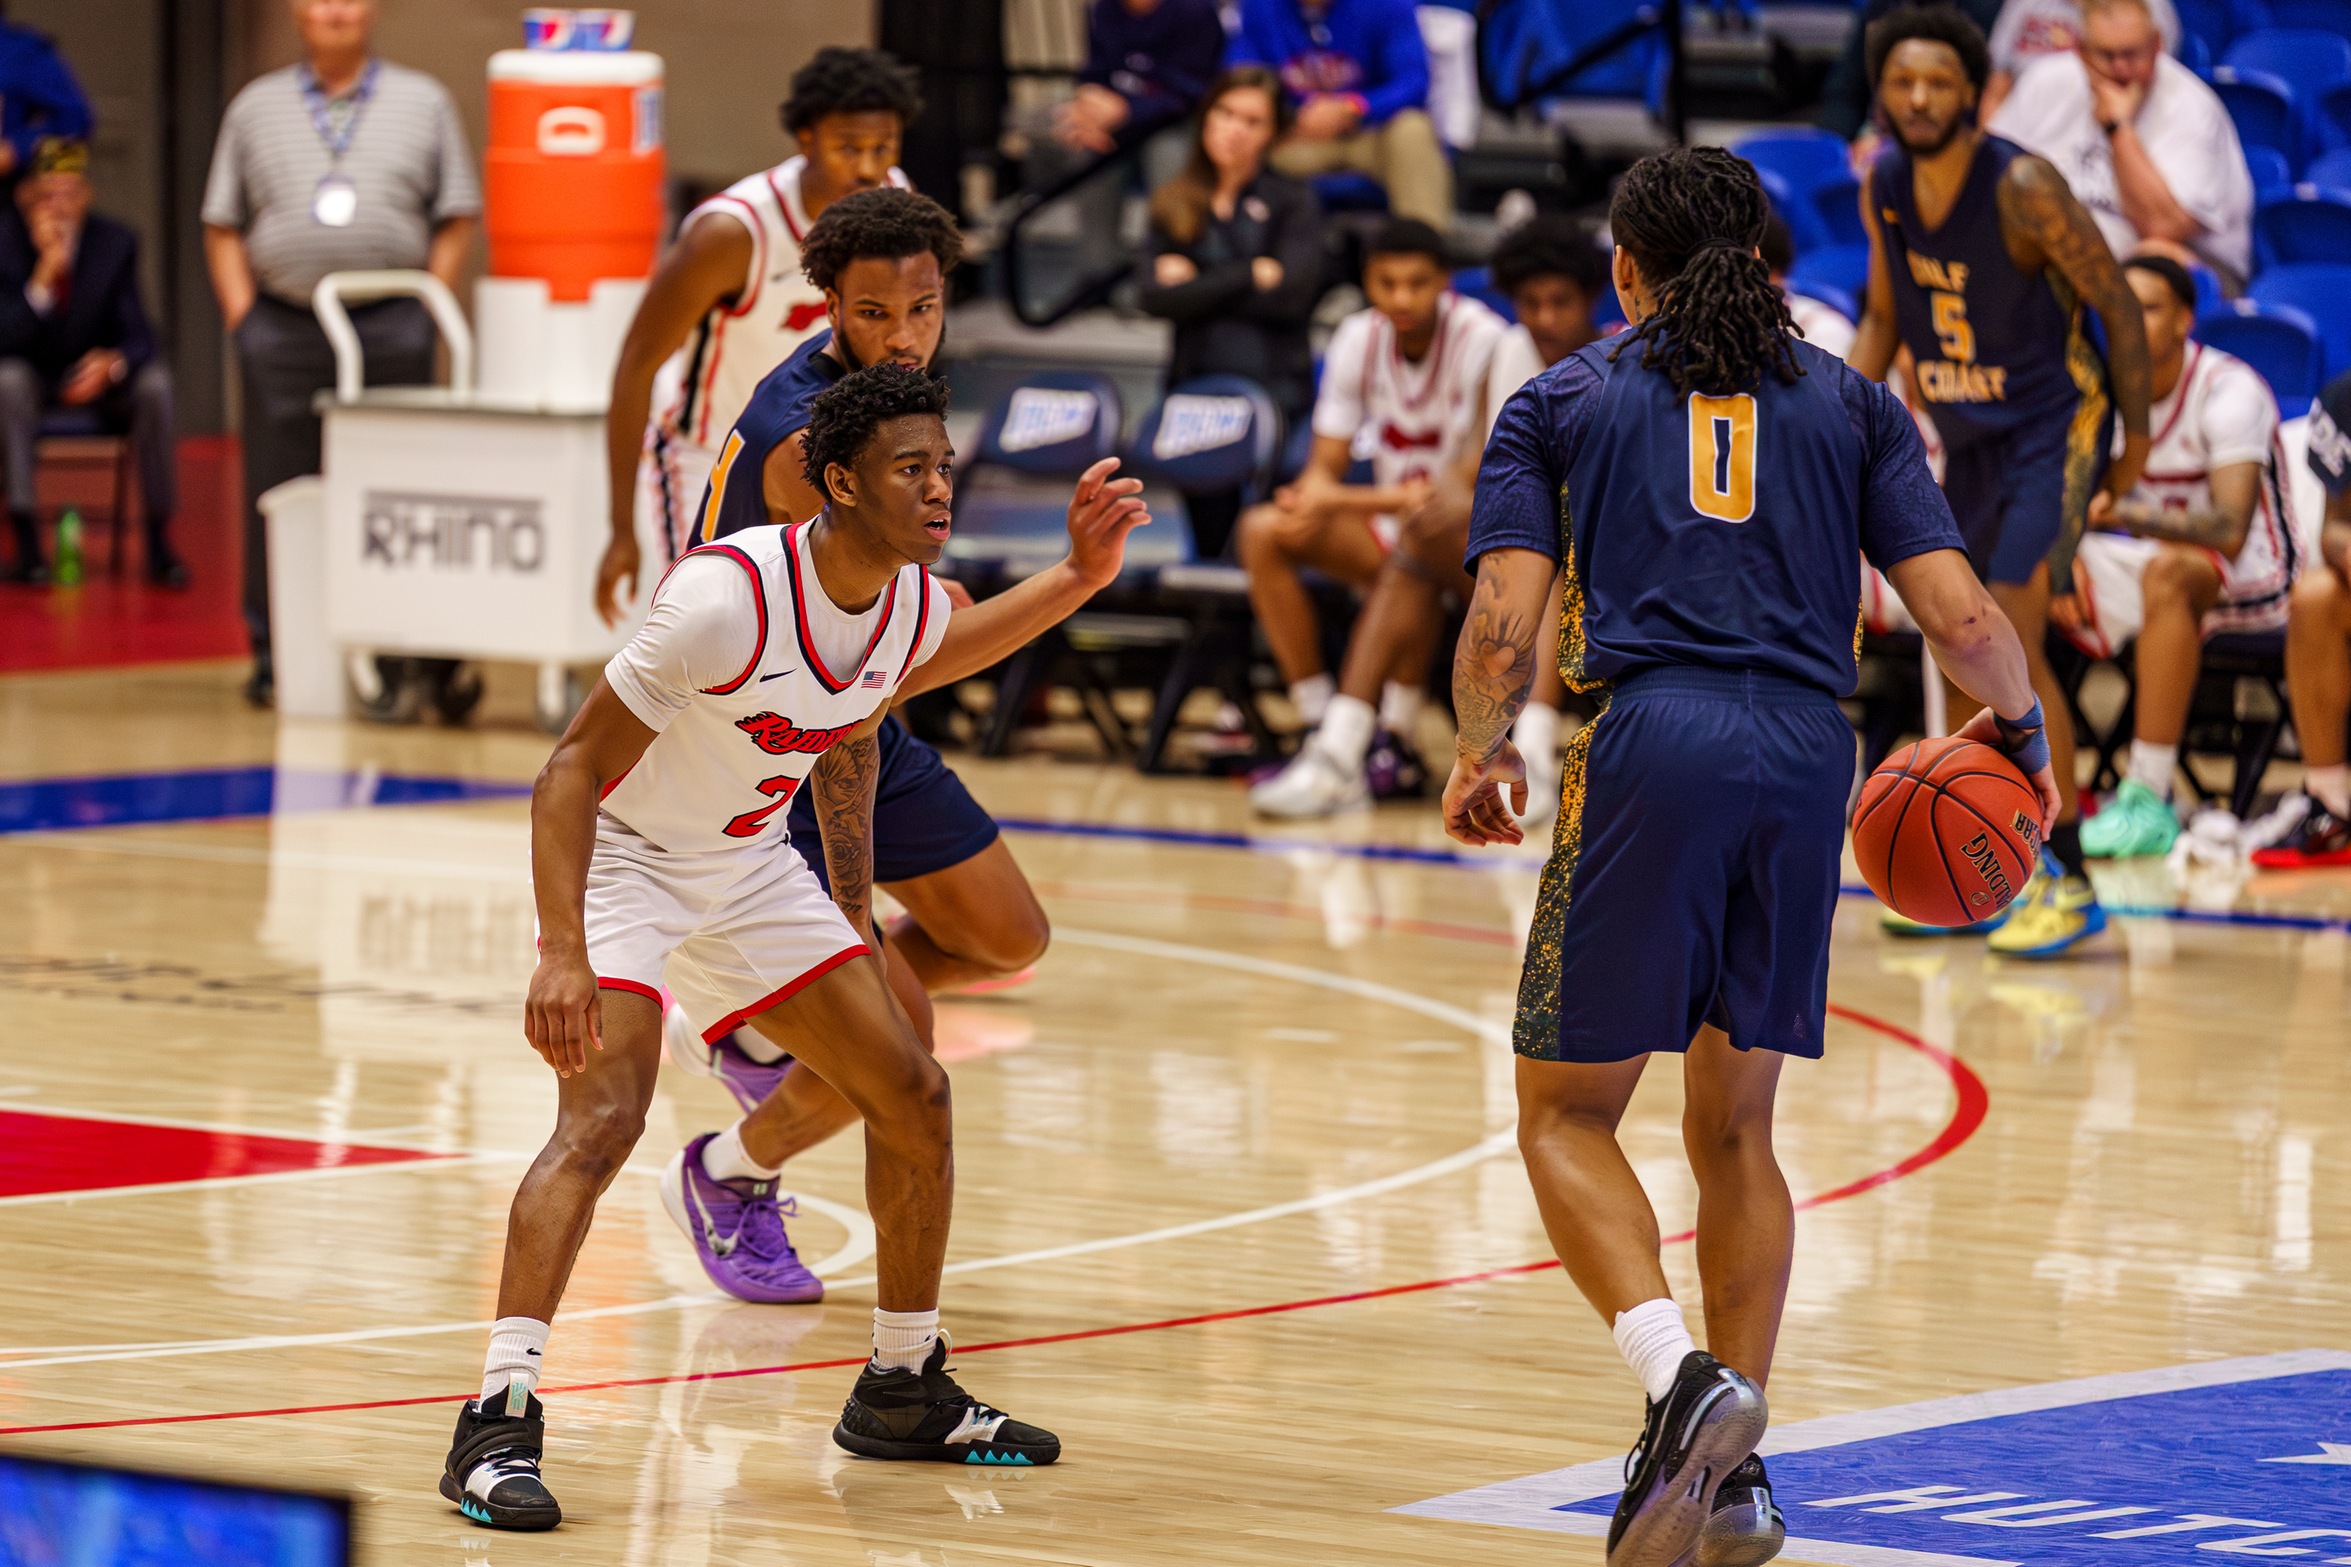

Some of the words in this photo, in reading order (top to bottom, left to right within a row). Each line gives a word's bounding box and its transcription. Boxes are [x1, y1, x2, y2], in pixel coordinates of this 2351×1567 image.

[1931, 290, 1976, 364] 5
[1688, 391, 1757, 523] 0
[361, 503, 547, 574] RHINO
[734, 710, 864, 755] RAIDE
[722, 775, 801, 838] 2
[1960, 831, 2013, 911] ALDING
[1803, 1485, 2351, 1566] HUTC
